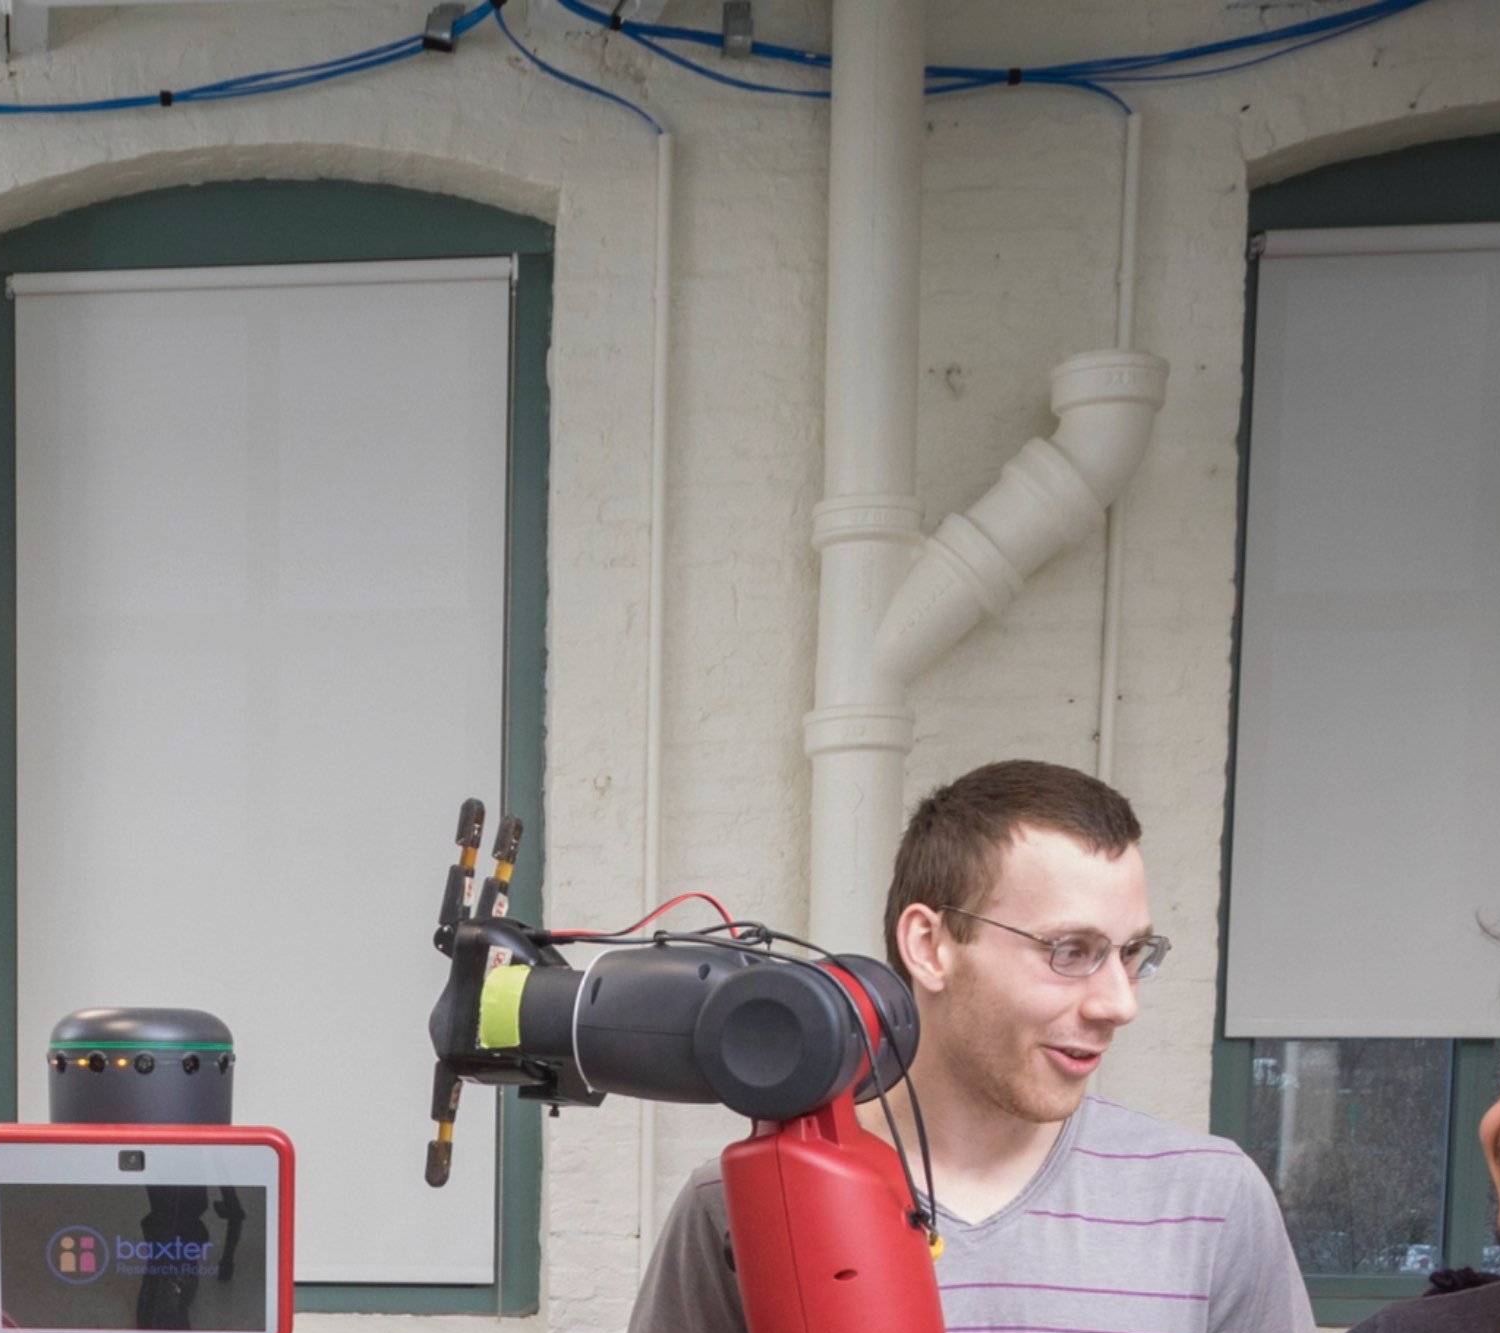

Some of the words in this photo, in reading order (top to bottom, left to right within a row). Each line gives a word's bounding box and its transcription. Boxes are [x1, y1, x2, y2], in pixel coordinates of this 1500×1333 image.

[115, 1234, 214, 1261] baxter
[116, 1263, 178, 1275] Research
[181, 1263, 220, 1276] Robot
